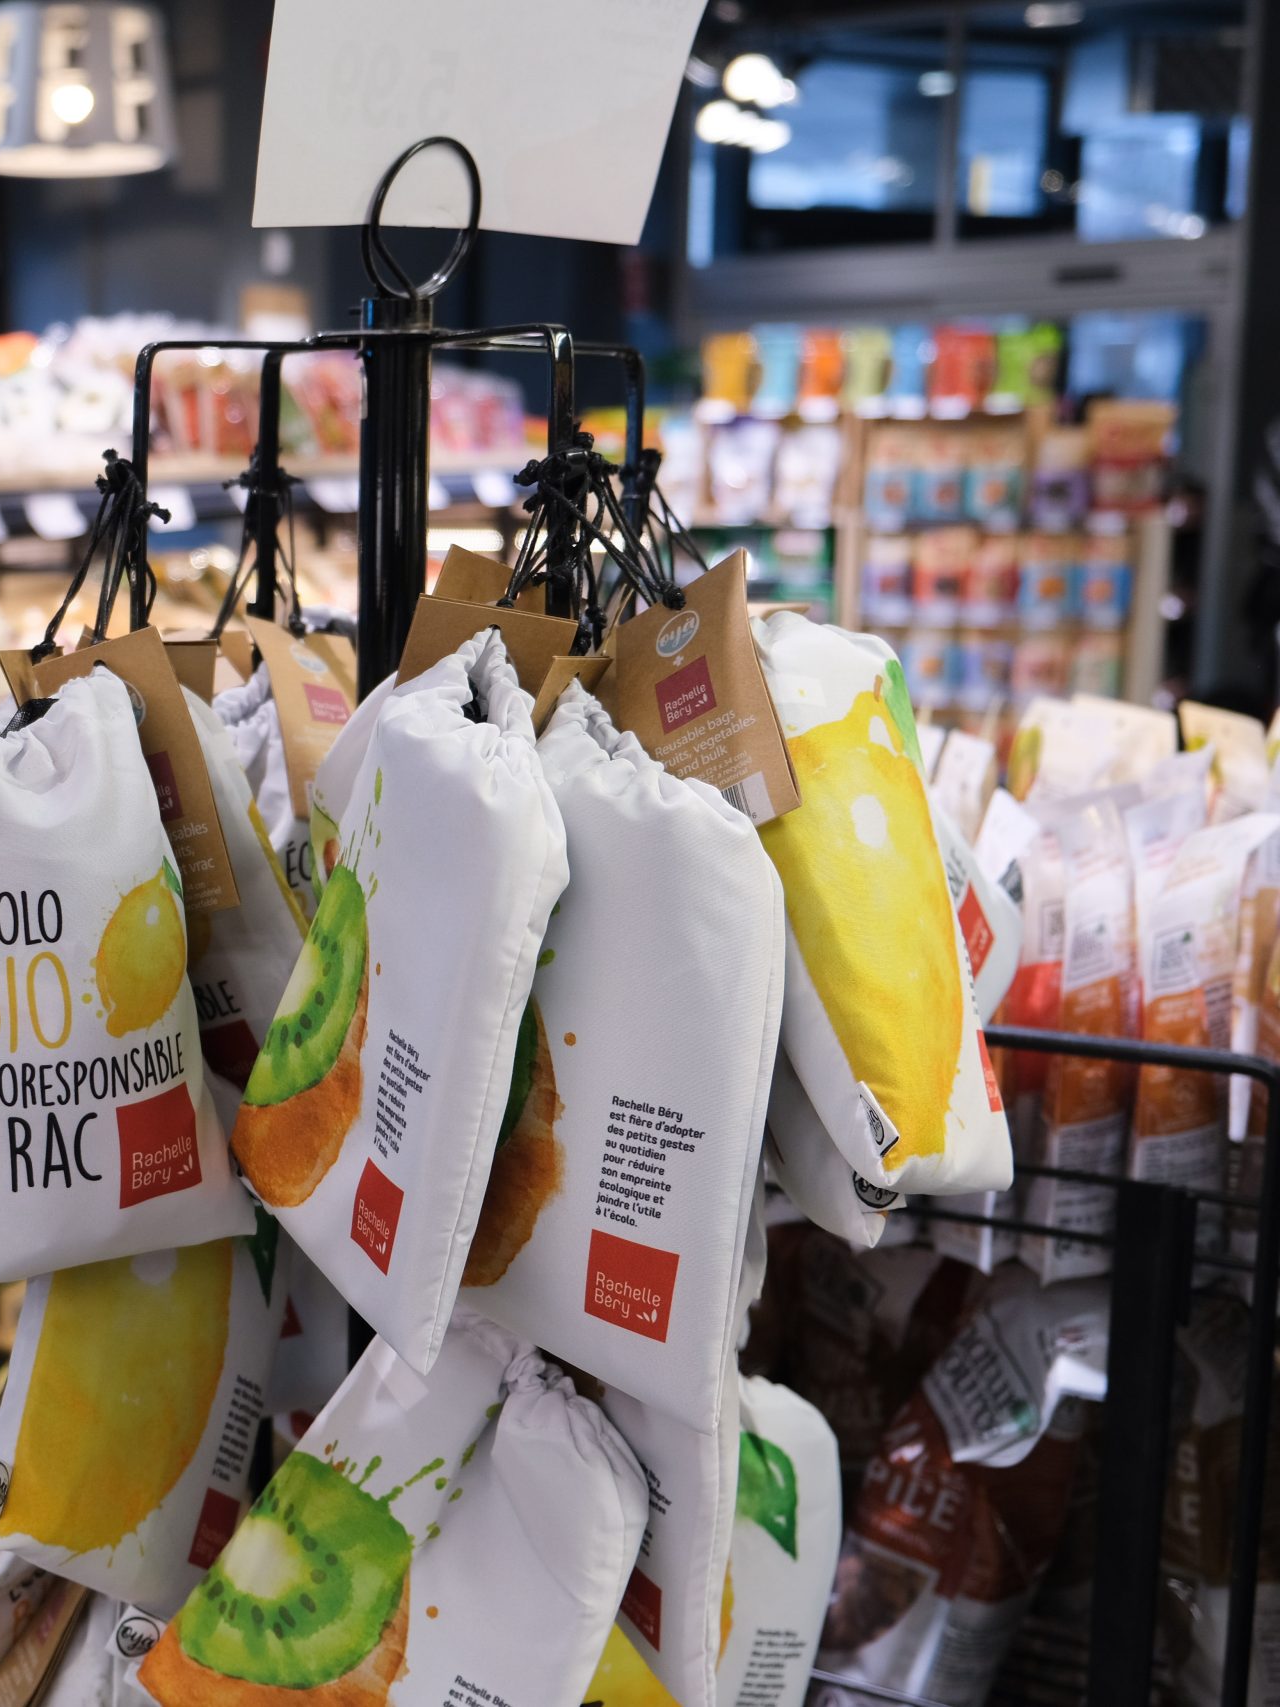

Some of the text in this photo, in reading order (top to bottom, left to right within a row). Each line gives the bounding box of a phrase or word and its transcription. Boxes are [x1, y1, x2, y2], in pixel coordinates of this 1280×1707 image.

[664, 684, 707, 712] Rachelle
[655, 709, 736, 759] Reusable bags
[693, 714, 756, 754] vegetables
[678, 761, 699, 778] and
[701, 745, 728, 765] bulk
[190, 858, 215, 873] vrac
[612, 1095, 683, 1123] Rachelle Béry
[607, 1124, 696, 1153] des petits gestes
[609, 1111, 706, 1139] est fière d'adopter
[132, 1136, 191, 1171] Rachelle
[605, 1139, 666, 1161] au quotidien
[603, 1153, 665, 1176] pour réduire
[599, 1178, 665, 1206] écologique et
[601, 1166, 672, 1192] son empreinte
[596, 1192, 630, 1210] joindre
[358, 1198, 390, 1240] Rachelle
[596, 1271, 661, 1307] Rachelle
[449, 1689, 464, 1701] est
[454, 1674, 491, 1701] Rachelle
